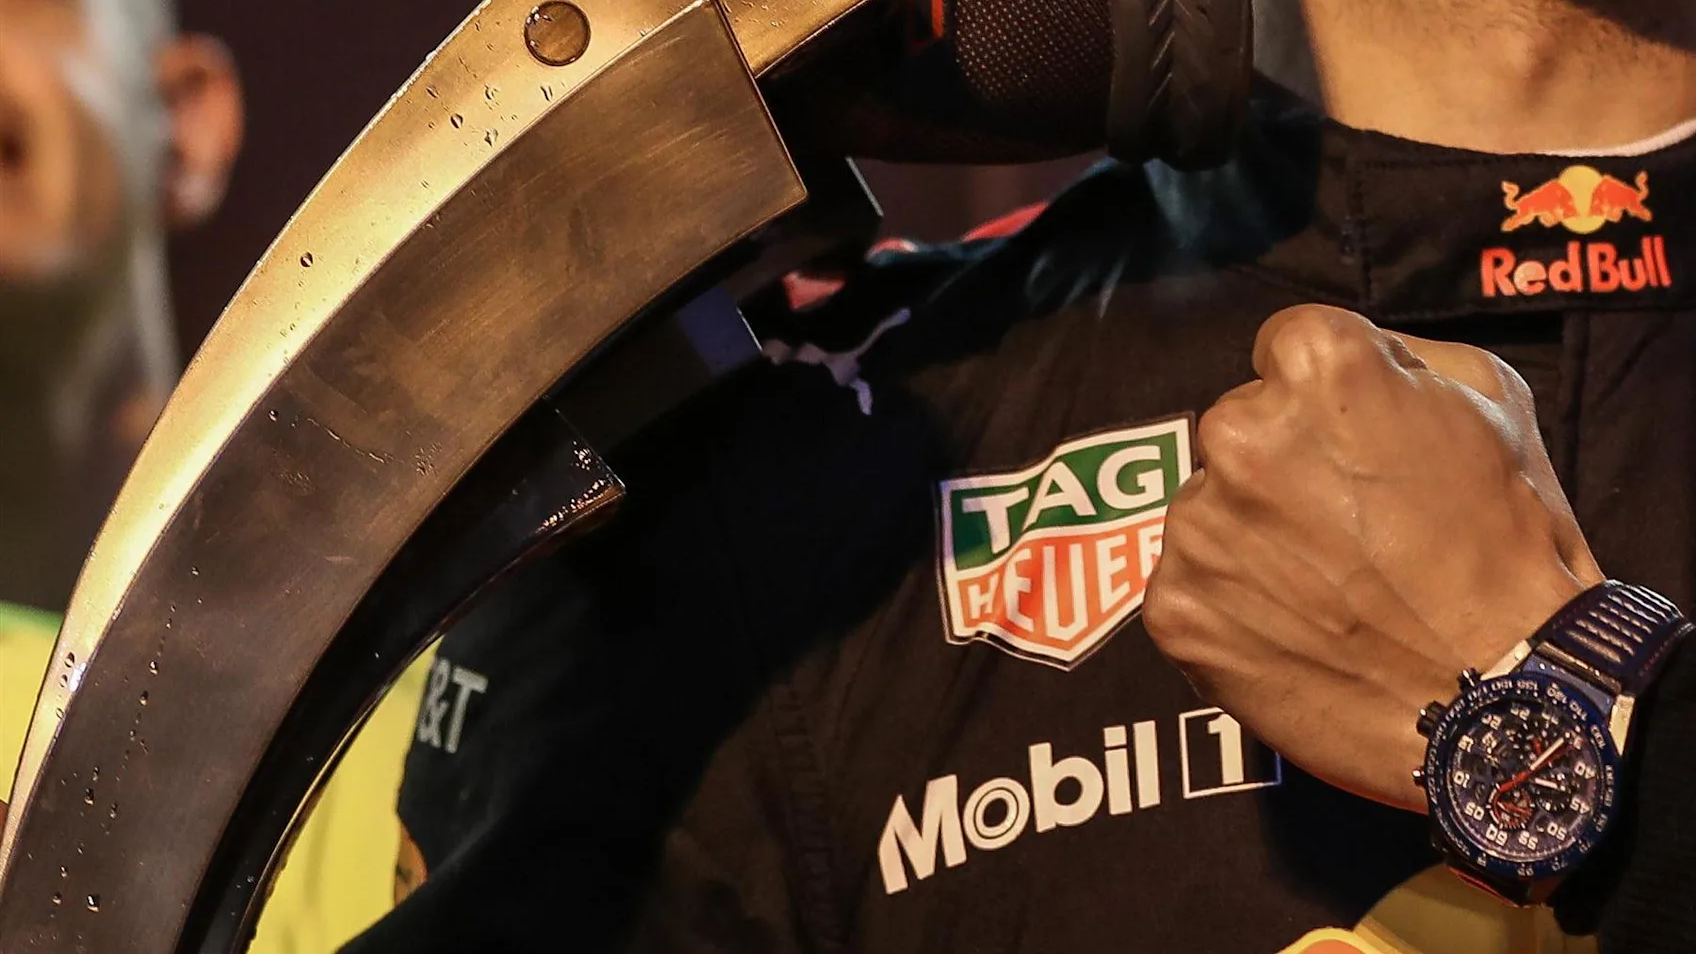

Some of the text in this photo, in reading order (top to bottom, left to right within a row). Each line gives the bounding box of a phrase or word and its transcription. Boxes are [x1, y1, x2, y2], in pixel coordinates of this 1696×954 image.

[1480, 236, 1671, 297] Red Bull
[961, 444, 1165, 554] TAG
[878, 713, 1245, 894] Mobil 1
